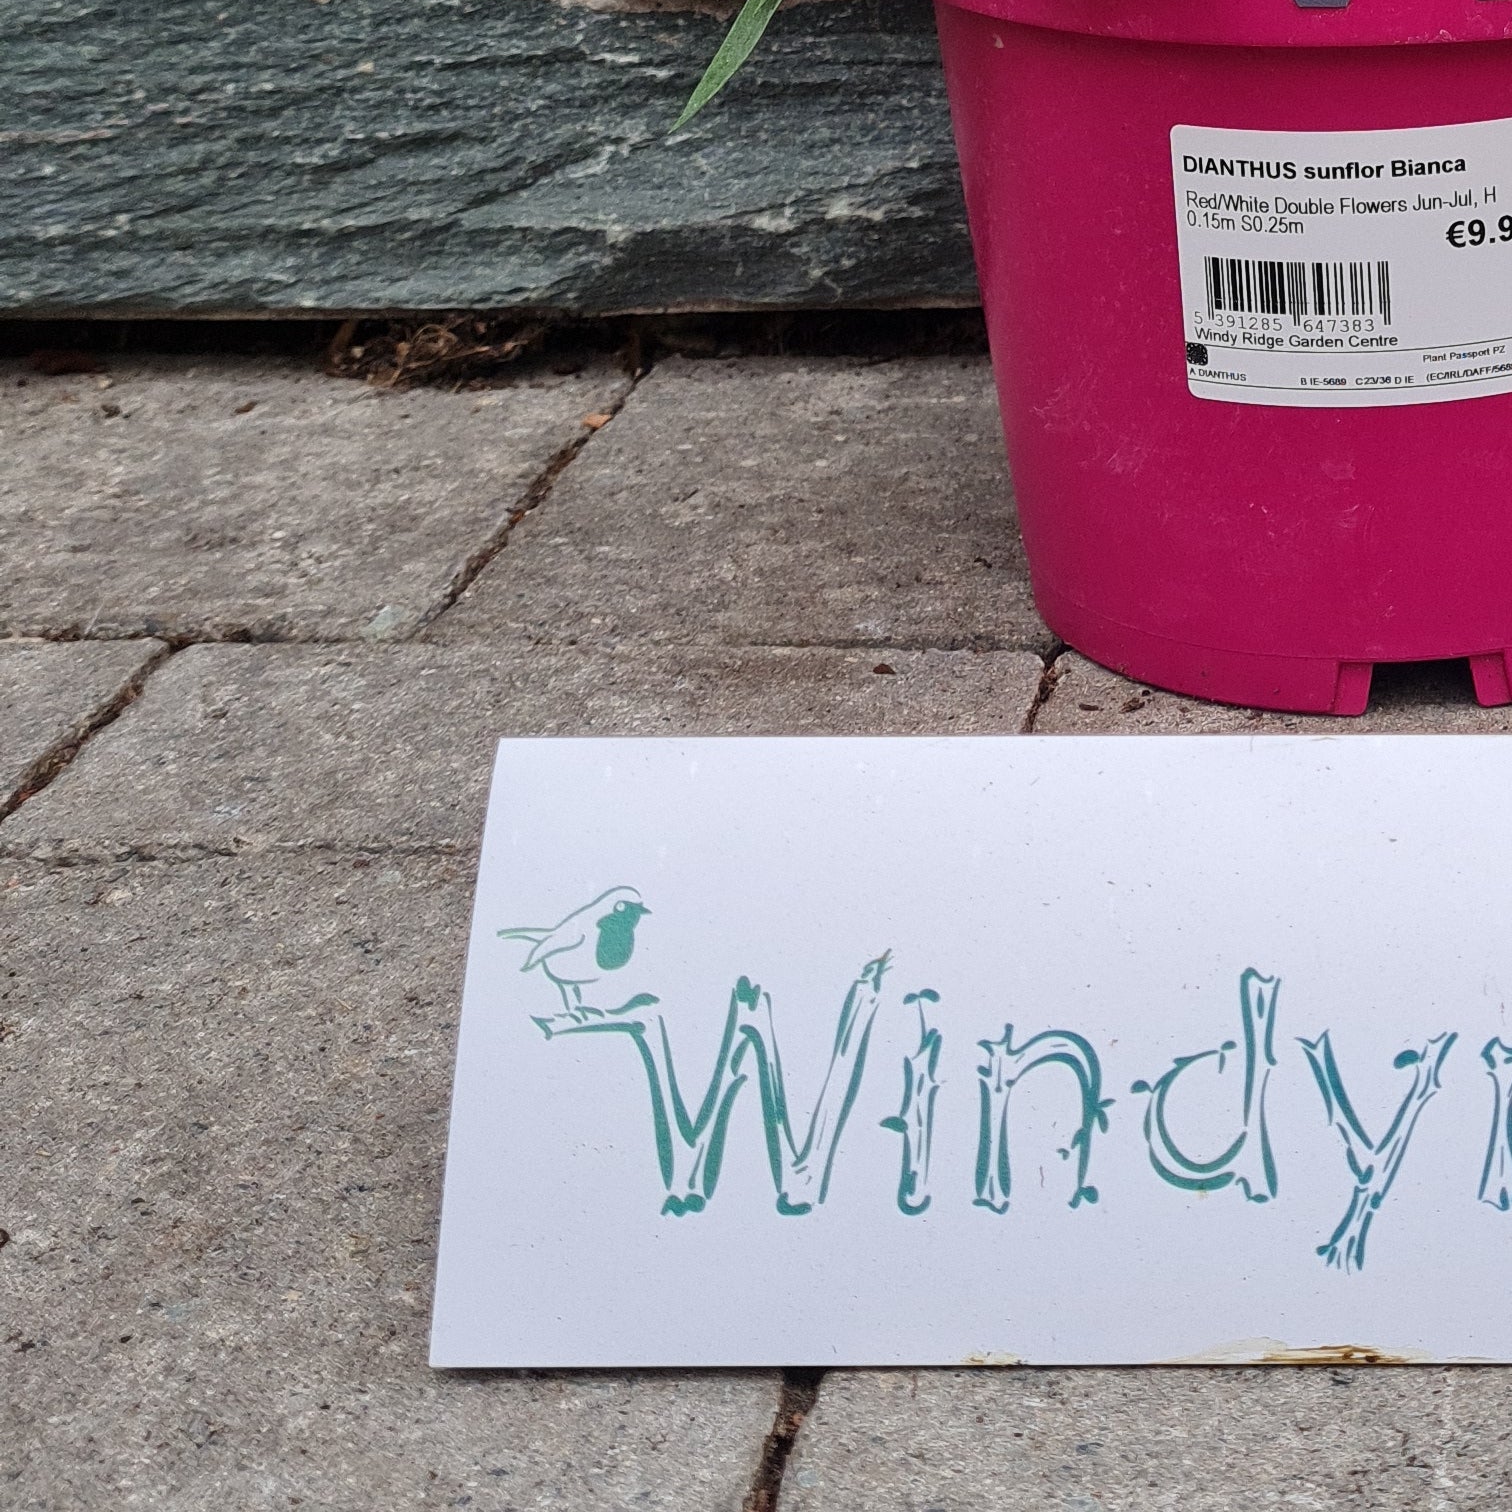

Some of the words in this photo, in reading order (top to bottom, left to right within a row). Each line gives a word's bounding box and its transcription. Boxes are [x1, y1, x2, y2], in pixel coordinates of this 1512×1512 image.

[1183, 155, 1297, 180] DIANTHUS
[1304, 161, 1385, 180] sunflor
[1391, 156, 1466, 178] Bianca
[1186, 191, 1270, 215] Red/White
[1275, 196, 1335, 215] Double
[1340, 195, 1408, 215] Flowers
[1412, 190, 1478, 212] Jun-Jul,
[1484, 186, 1497, 203] H
[1187, 212, 1236, 232] 0.15m
[1241, 214, 1305, 235] S0.25m
[1194, 311, 1204, 325] 5
[1215, 313, 1283, 332] 391285
[1304, 319, 1375, 333] 647383
[1194, 326, 1238, 346] Windy
[1243, 332, 1284, 349] Ridge
[1289, 335, 1344, 348] Garden
[1349, 335, 1398, 348] Centre
[1423, 353, 1447, 362] Plant
[1450, 347, 1490, 361] Passport
[1493, 345, 1506, 355] PZ
[1190, 368, 1196, 376] A
[1198, 368, 1247, 381] DIANTHUS
